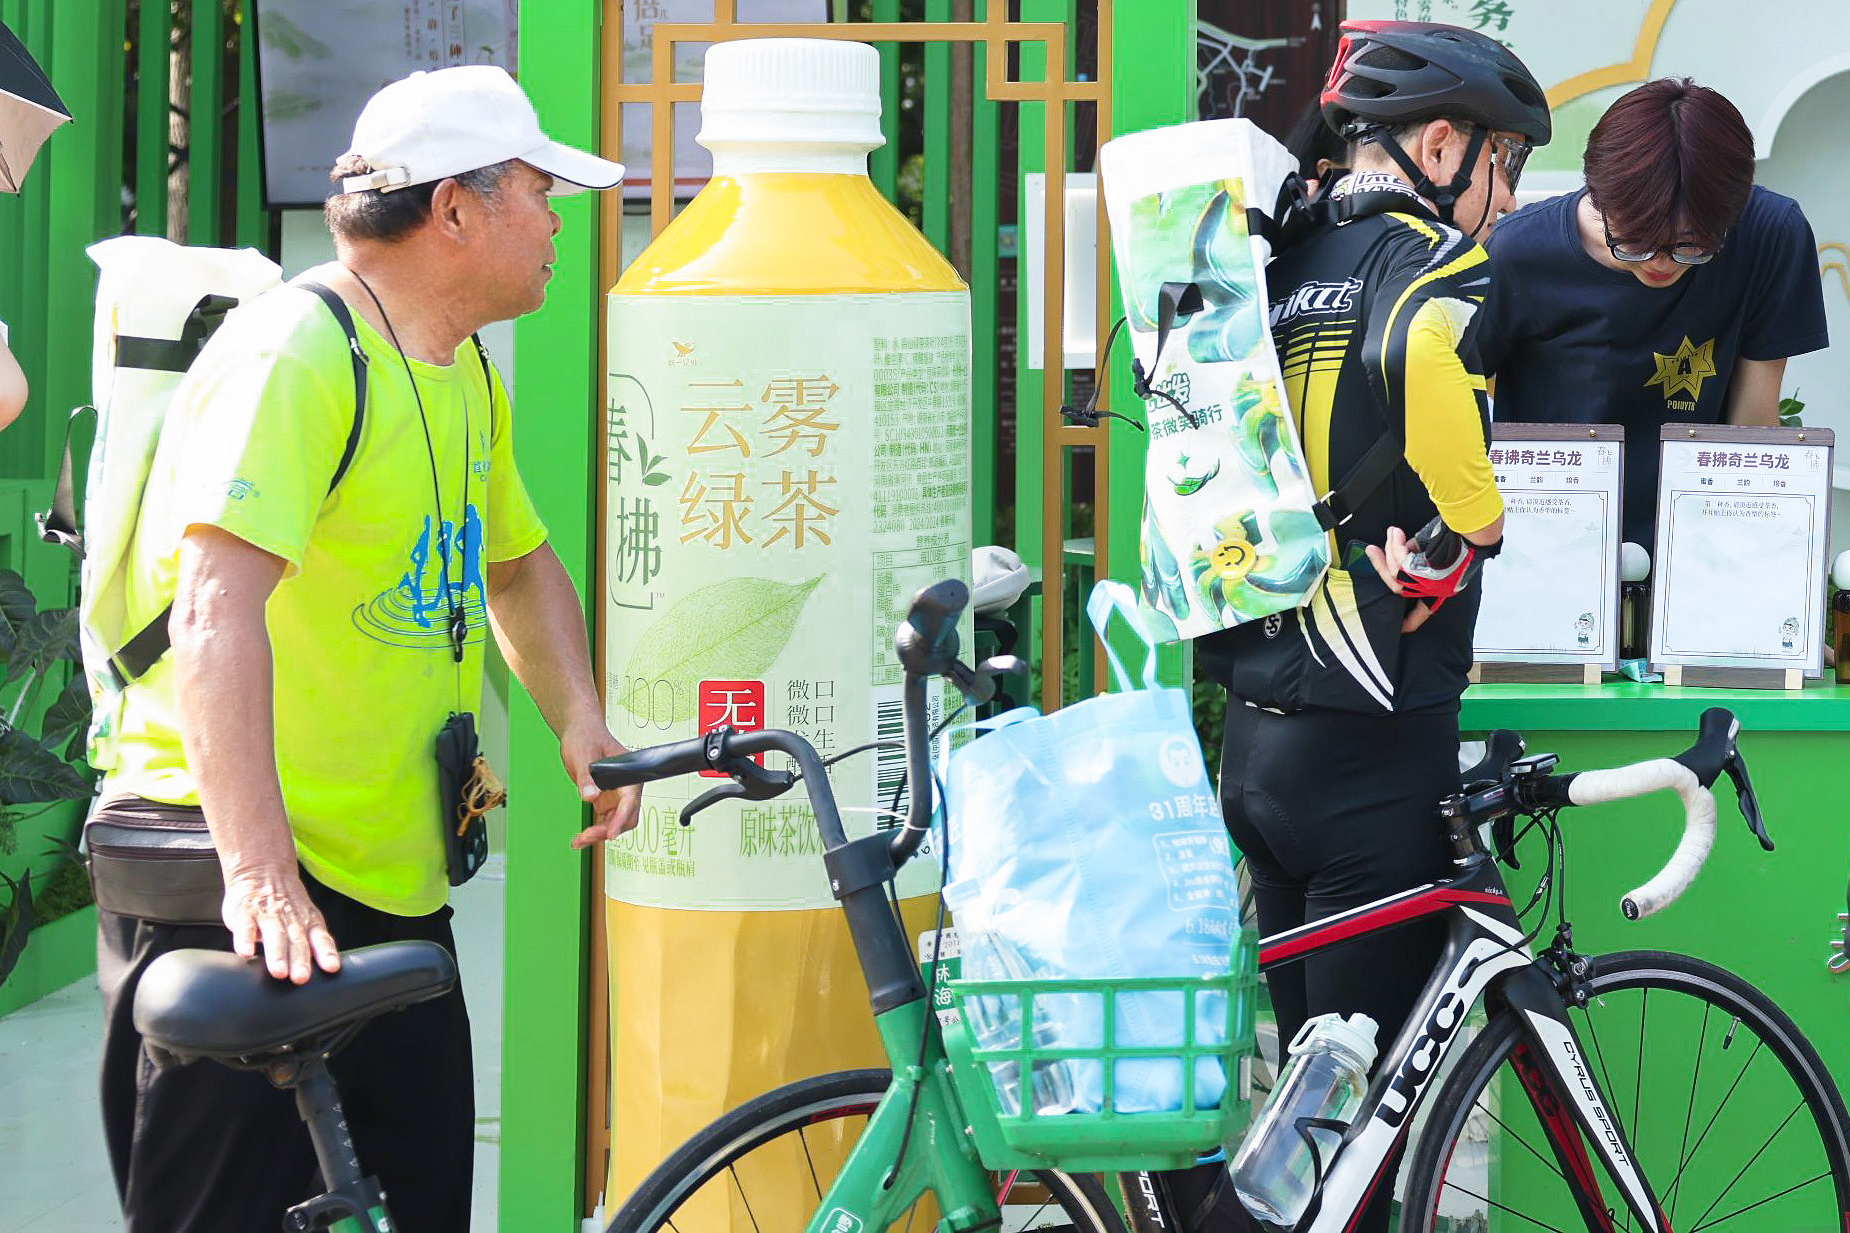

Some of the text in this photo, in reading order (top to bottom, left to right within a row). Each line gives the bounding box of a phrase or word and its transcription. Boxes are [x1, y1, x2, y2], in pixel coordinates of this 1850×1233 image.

[679, 374, 840, 460] 云雾
[1489, 449, 1582, 466] 春拂奇兰乌龙
[1697, 451, 1790, 470] 春拂奇兰乌龙
[678, 469, 840, 551] 绿茶
[739, 805, 824, 858] 原味茶饮
[1563, 1041, 1630, 1167] CYRUS SPORT
